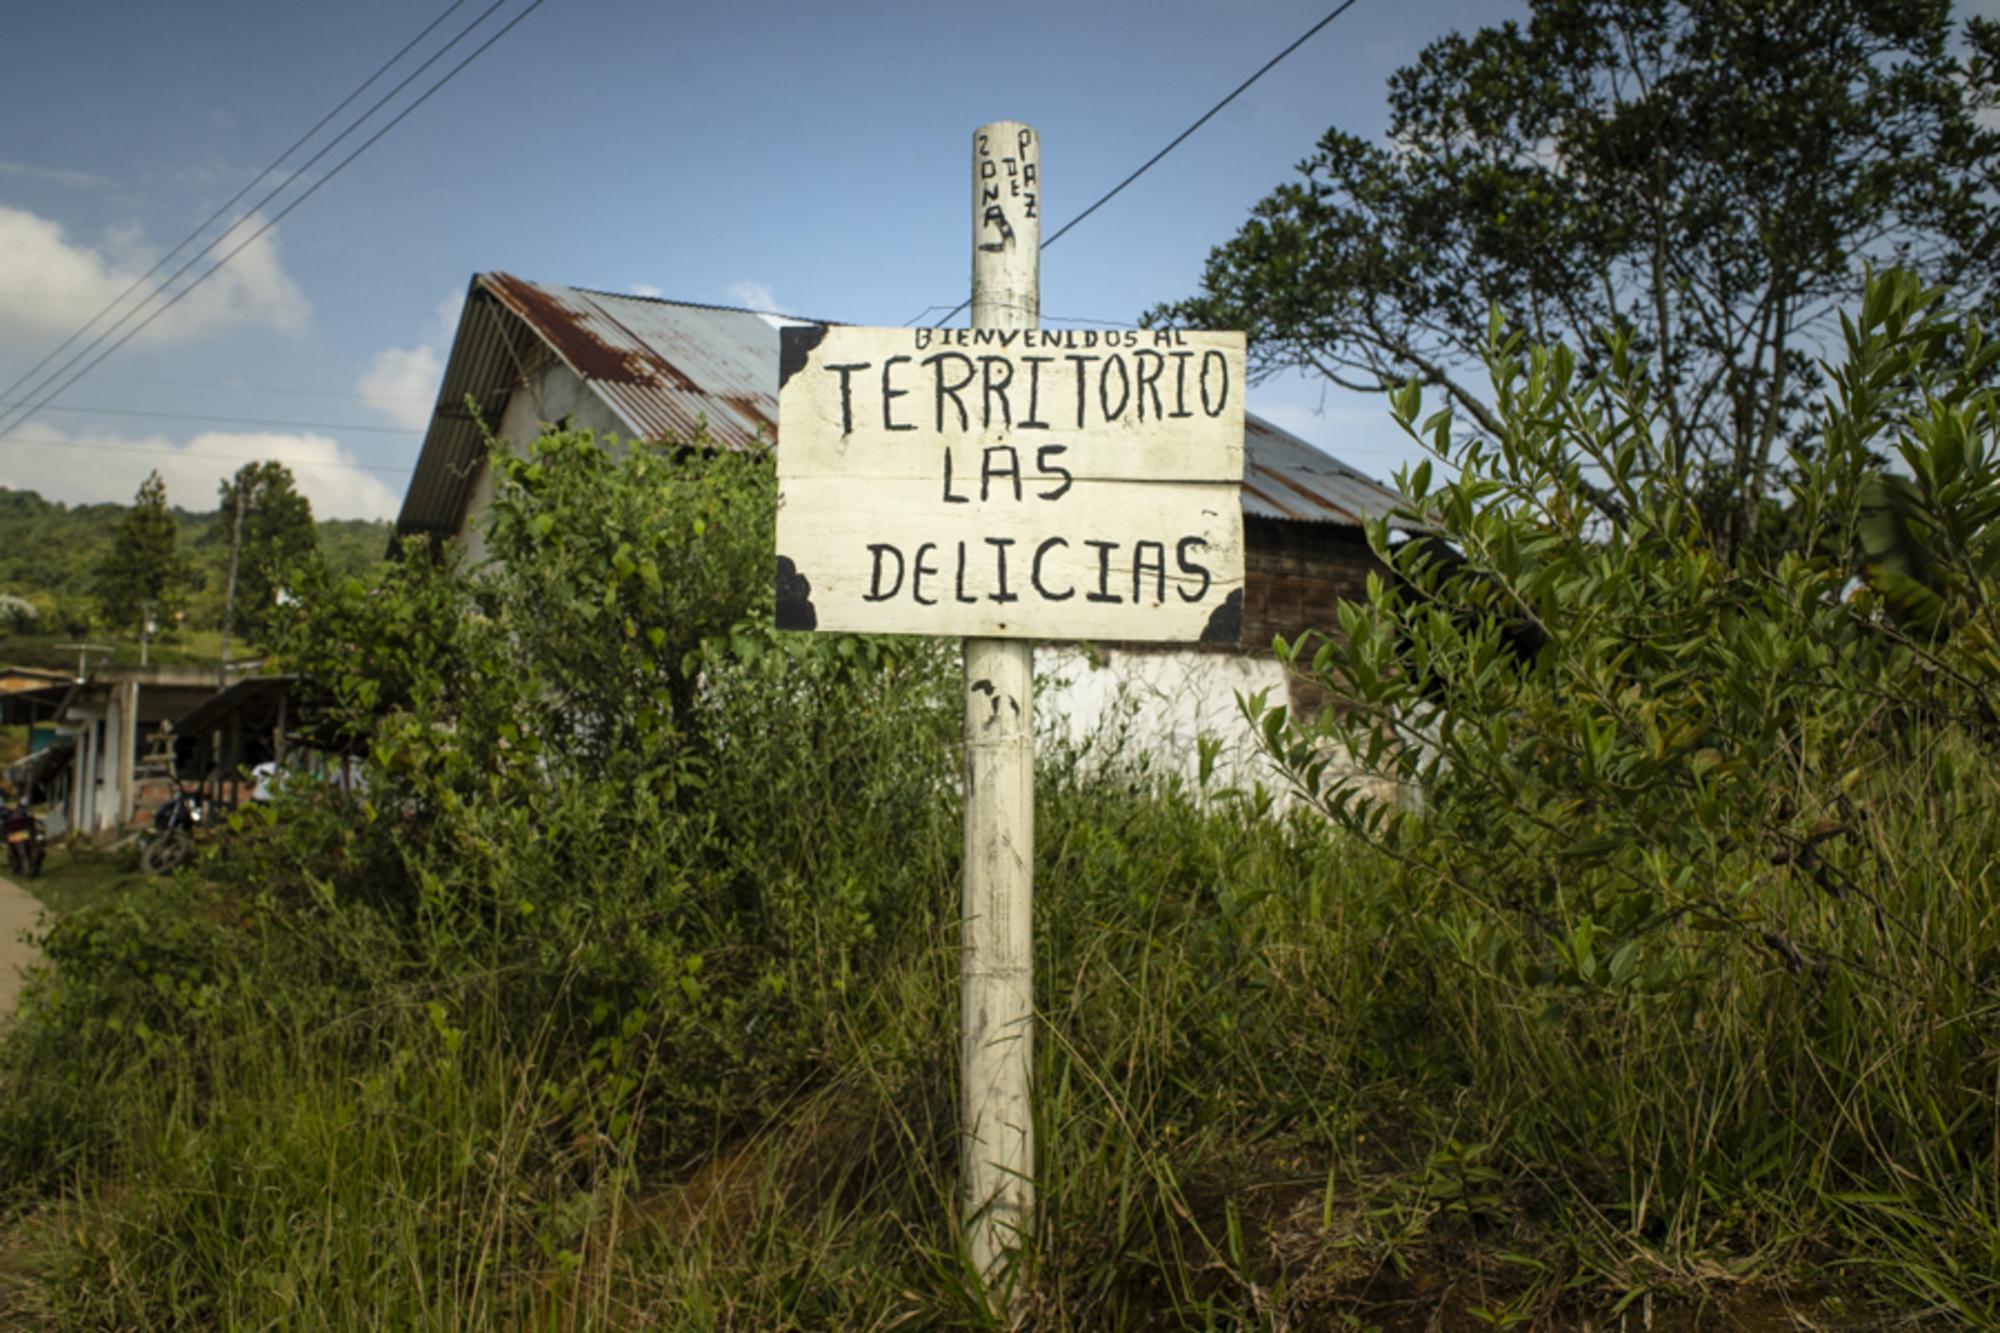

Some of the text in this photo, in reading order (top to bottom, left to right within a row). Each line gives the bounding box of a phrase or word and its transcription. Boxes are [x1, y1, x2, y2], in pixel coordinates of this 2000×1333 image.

[1002, 158, 1019, 196] DE
[1018, 129, 1037, 218] PAZ
[915, 328, 1188, 350] BIENVENIDOS AL
[824, 350, 1228, 434] TERRITORIO
[943, 445, 1073, 503] LAS
[862, 536, 1212, 604] DELICIAS
